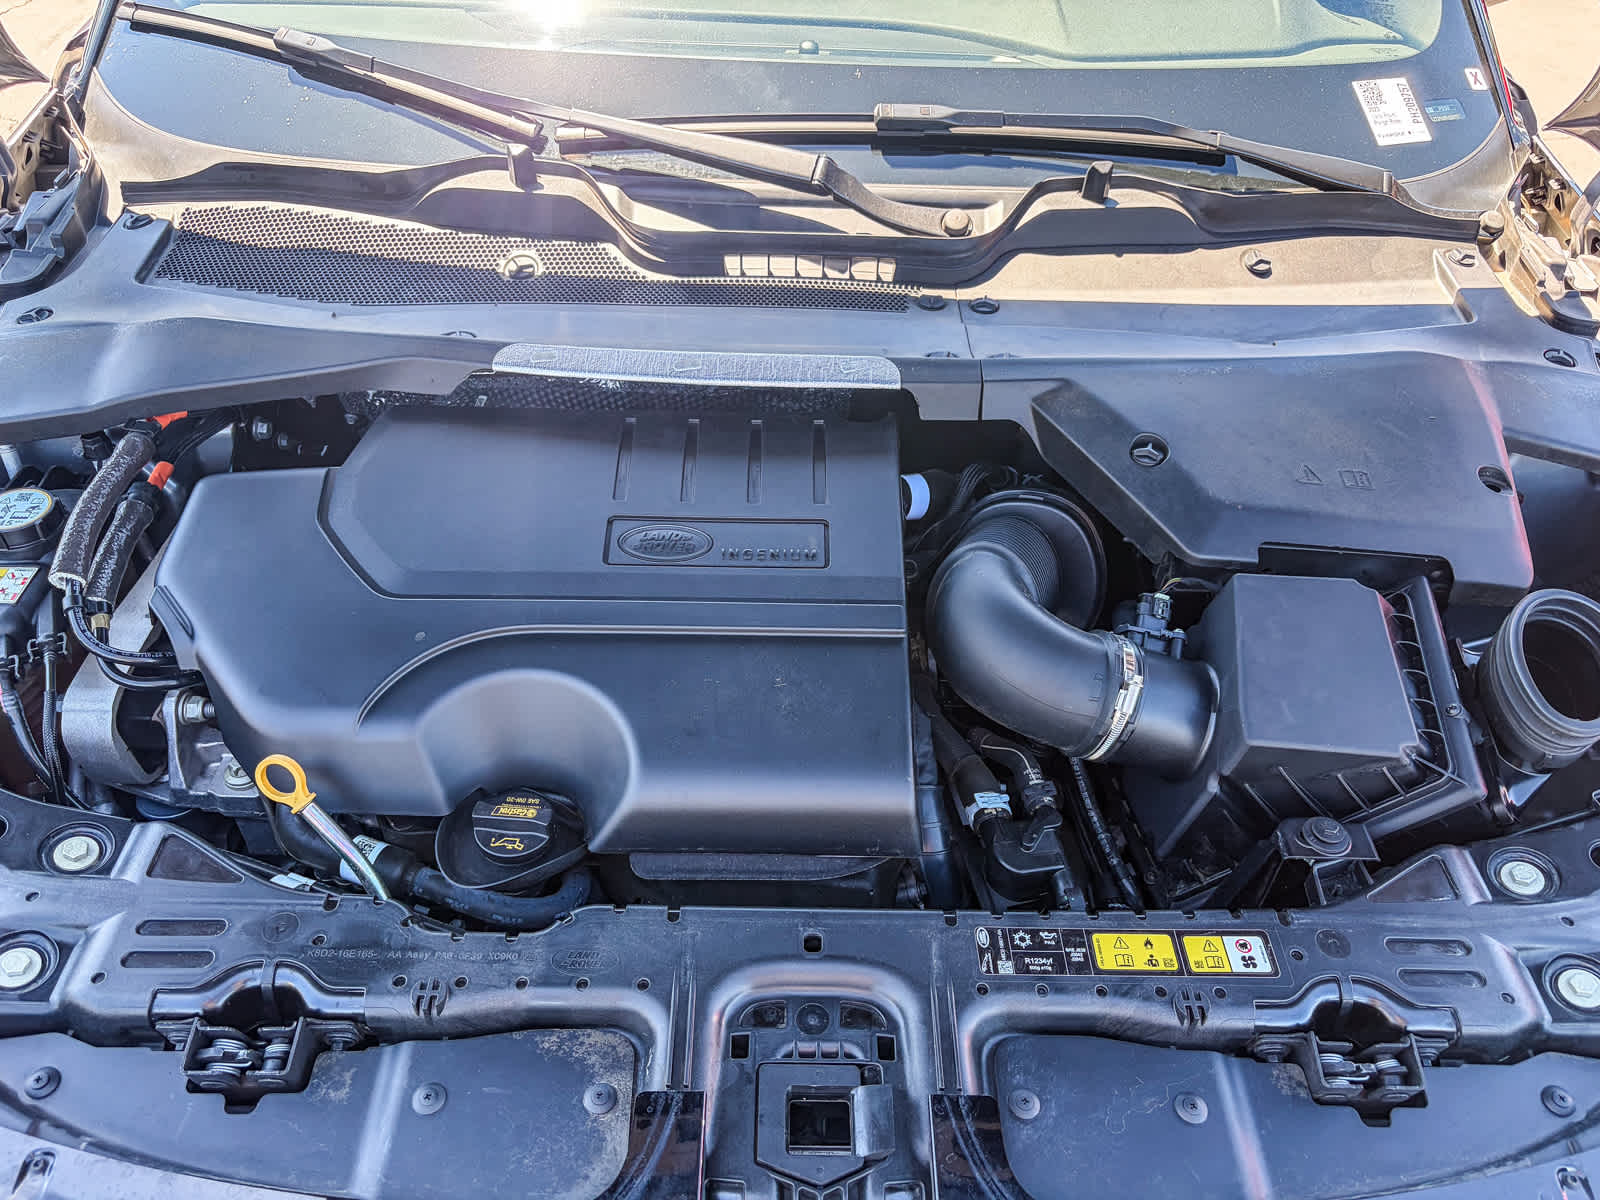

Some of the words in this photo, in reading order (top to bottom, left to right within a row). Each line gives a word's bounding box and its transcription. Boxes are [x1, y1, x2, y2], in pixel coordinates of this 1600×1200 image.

[1469, 71, 1483, 86] X
[639, 531, 683, 543] LAND
[638, 541, 697, 554] ROVER
[720, 548, 818, 562] INGENIUM
[498, 807, 527, 816] Castrol
[567, 950, 601, 959] LAND
[567, 958, 608, 969] ROVER
[1024, 956, 1054, 966] R1234yf
